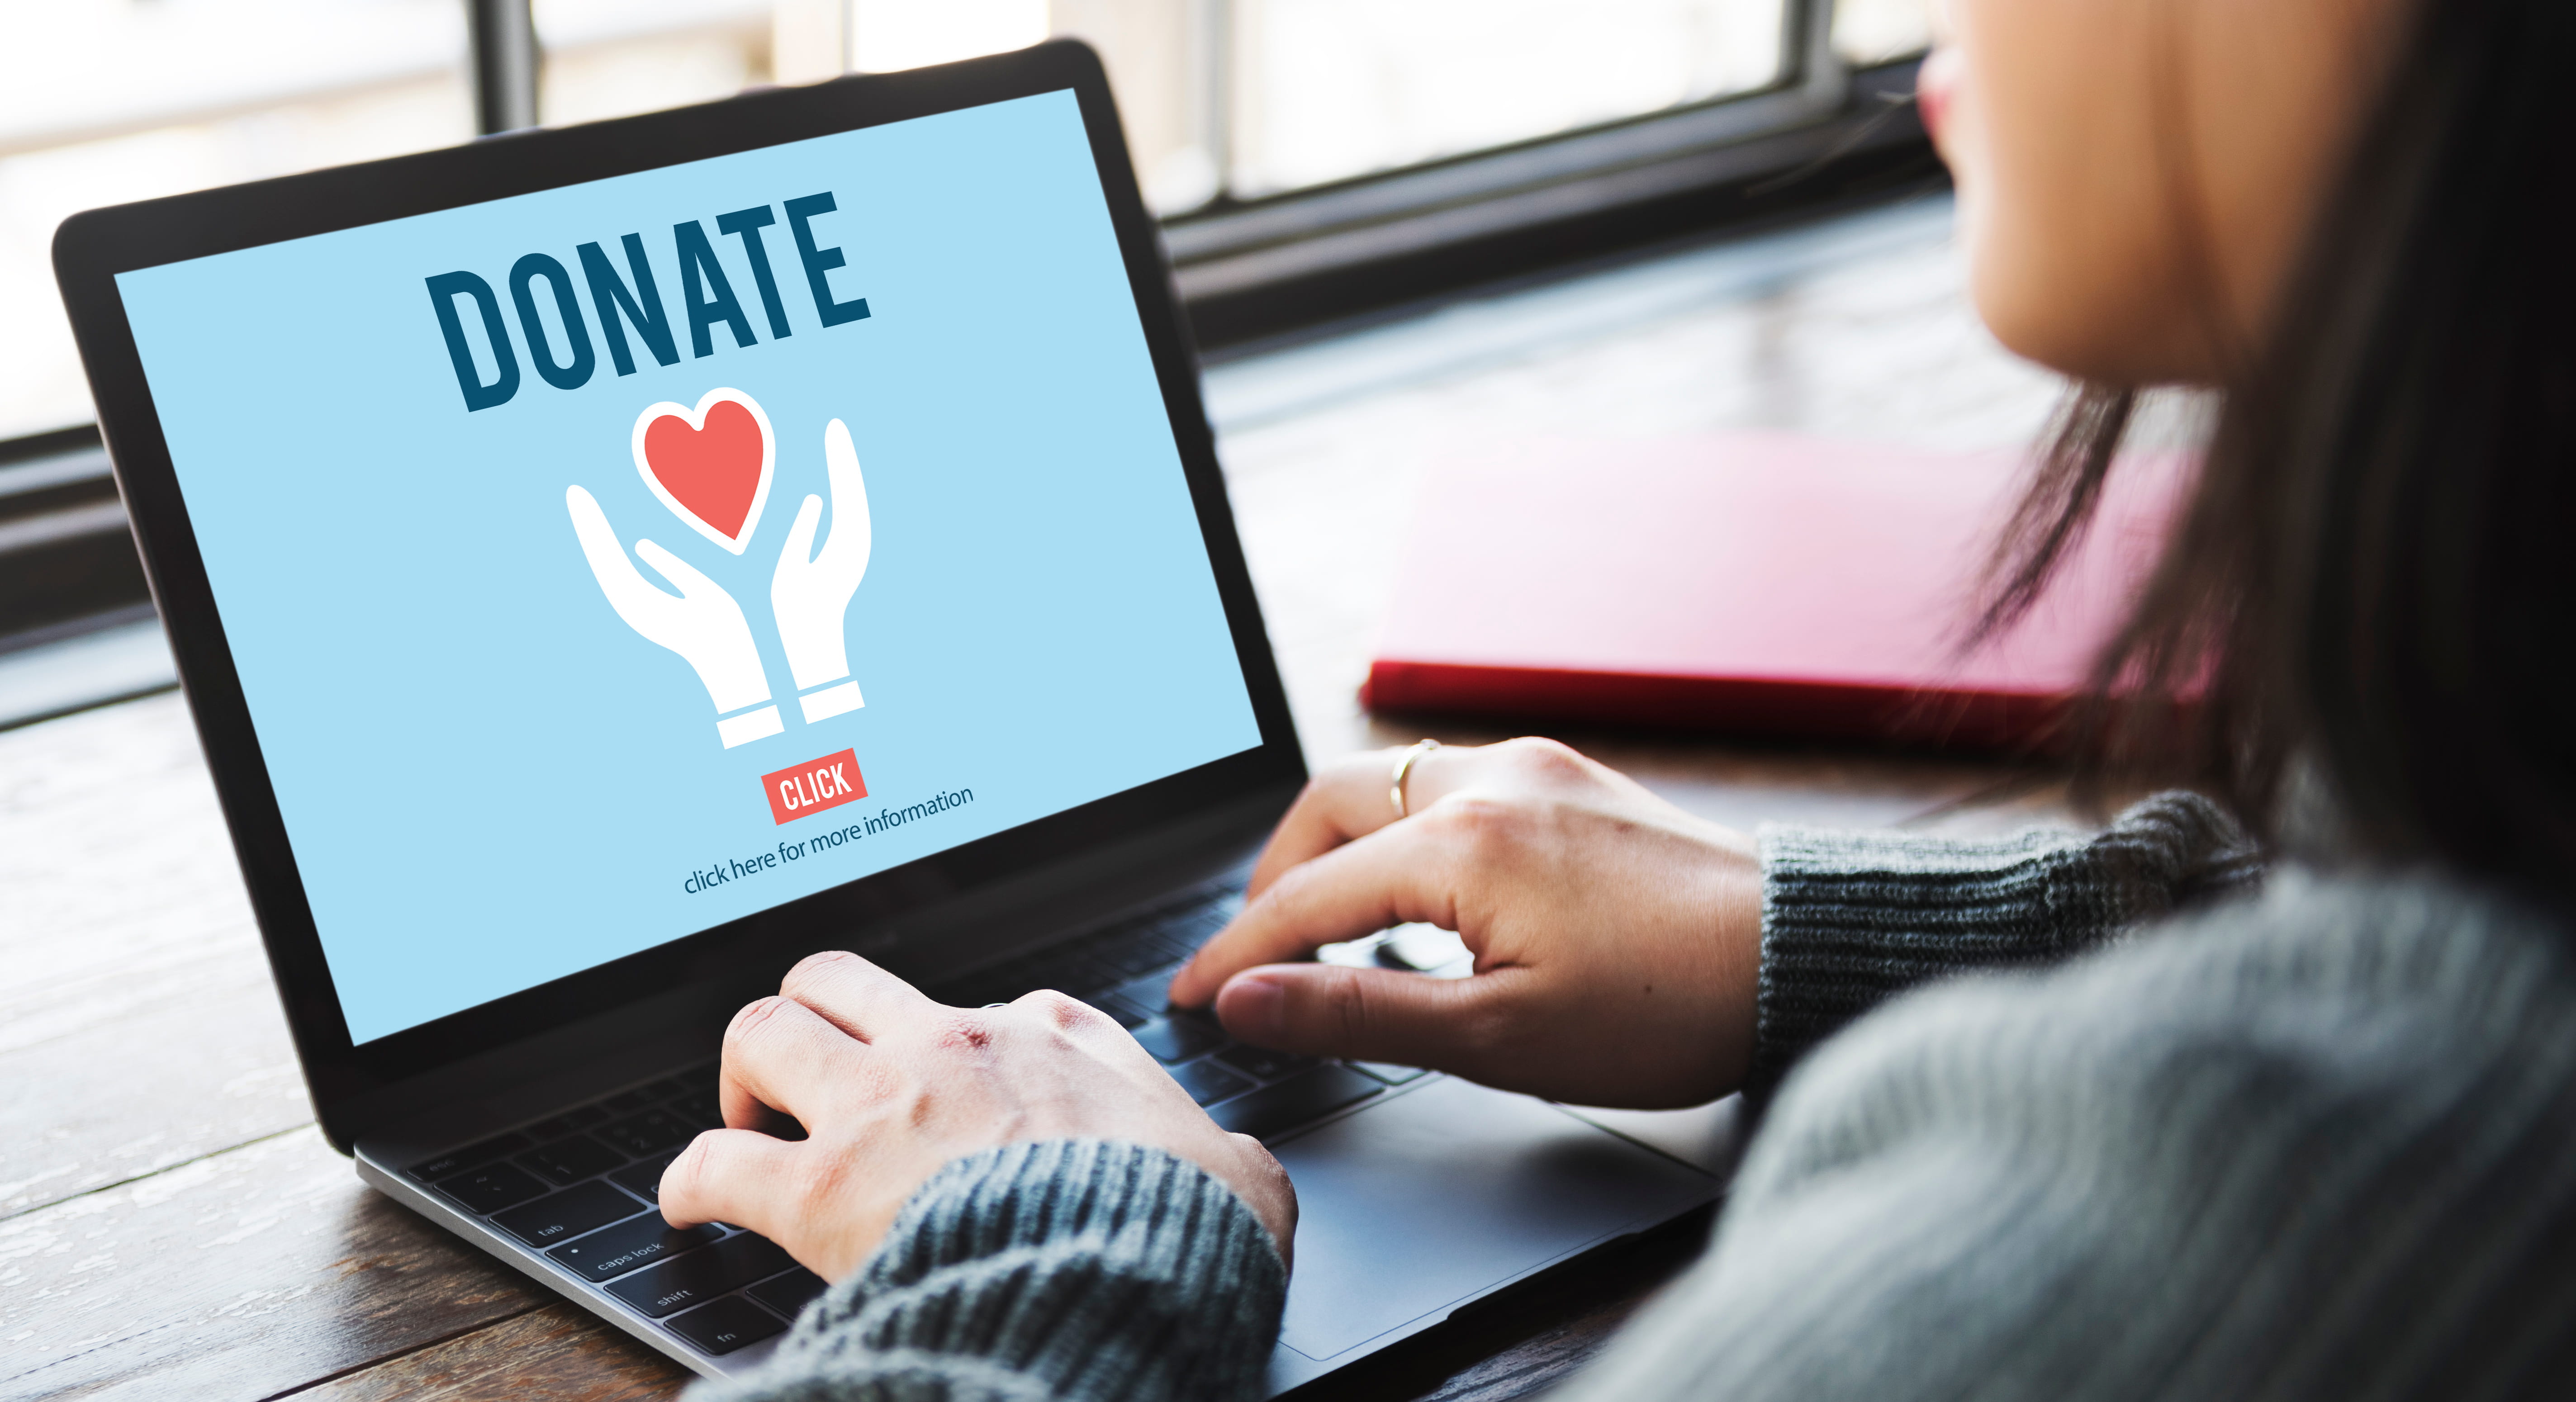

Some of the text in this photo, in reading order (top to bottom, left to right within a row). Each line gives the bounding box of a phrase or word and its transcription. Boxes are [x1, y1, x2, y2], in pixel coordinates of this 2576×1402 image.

[425, 191, 871, 412] DONATE
[779, 763, 853, 810] CLICK
[684, 788, 973, 894] click here for more information
[538, 1224, 564, 1236] tab
[597, 1242, 664, 1272] caps lock
[657, 1288, 693, 1307] shift
[716, 1332, 736, 1343] fn
